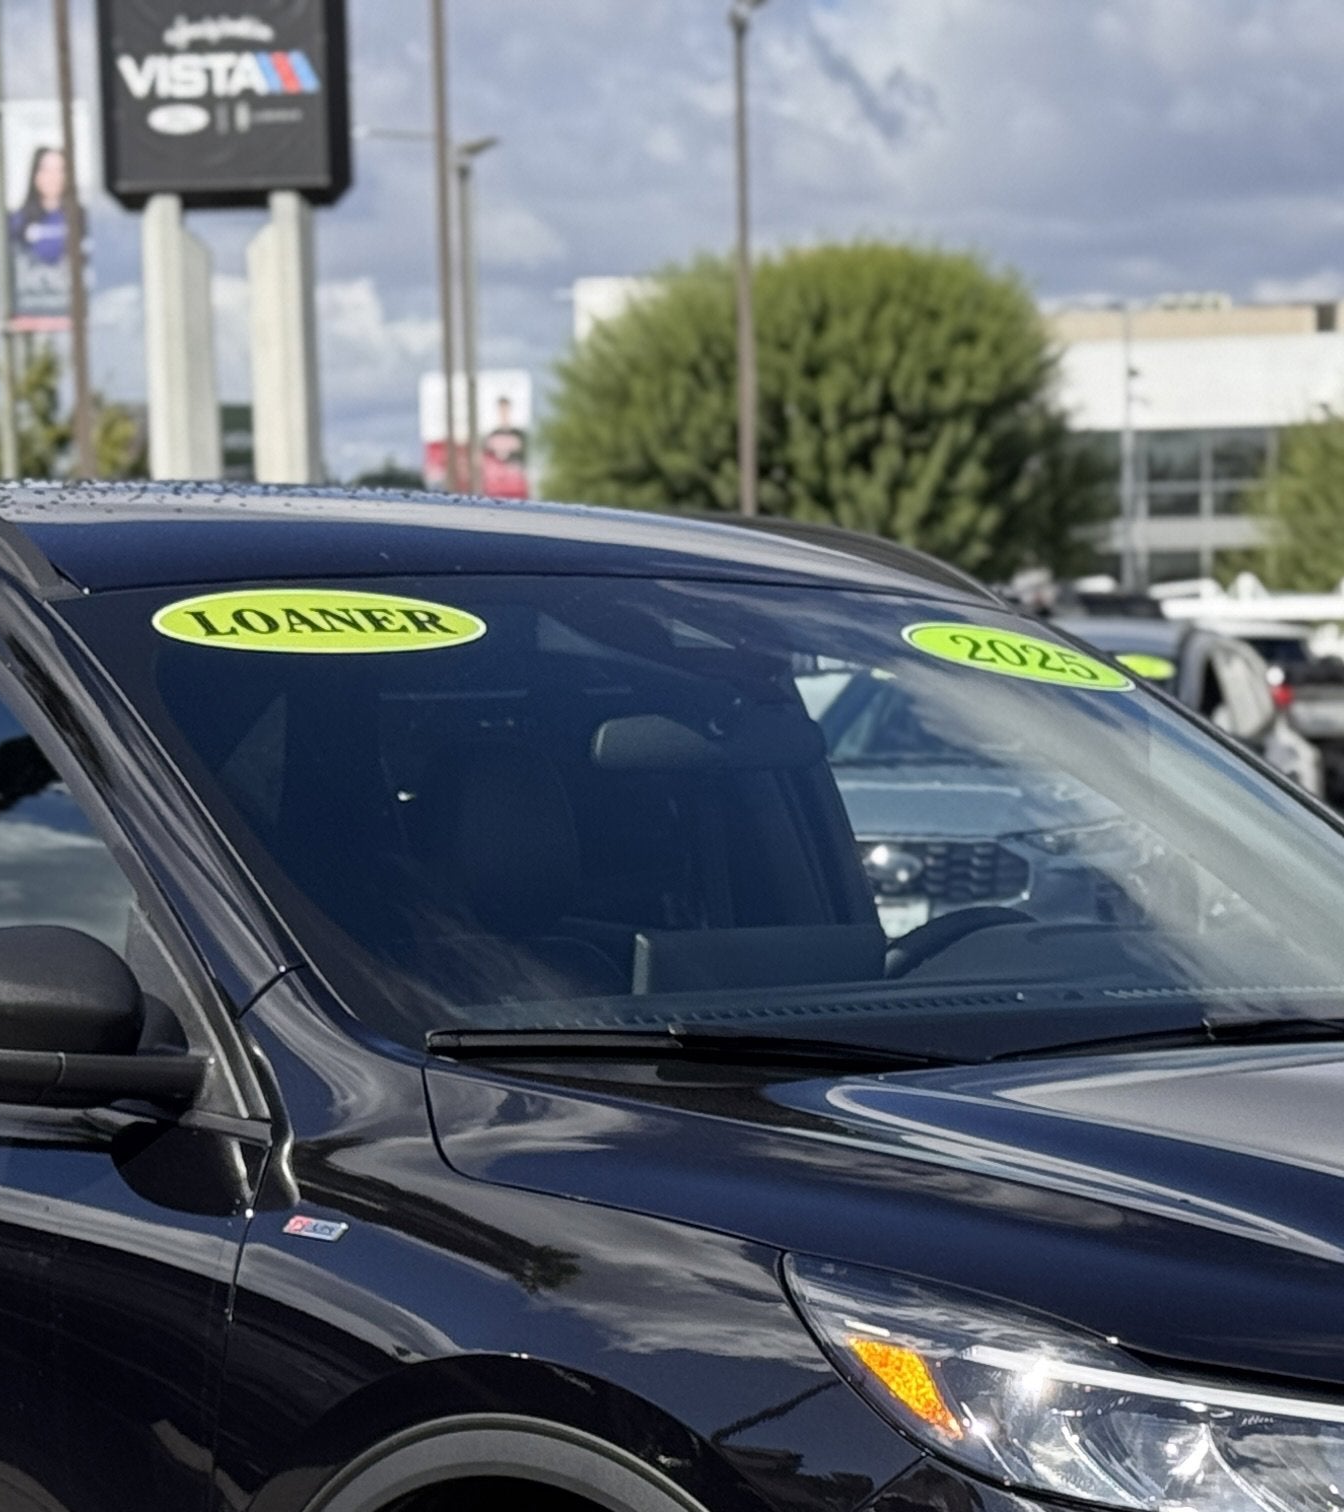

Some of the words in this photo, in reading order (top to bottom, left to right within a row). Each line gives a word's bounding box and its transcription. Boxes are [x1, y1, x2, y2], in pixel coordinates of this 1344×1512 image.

[116, 52, 269, 98] VISTA
[184, 607, 459, 638] LOANER
[949, 634, 1100, 681] 2025
